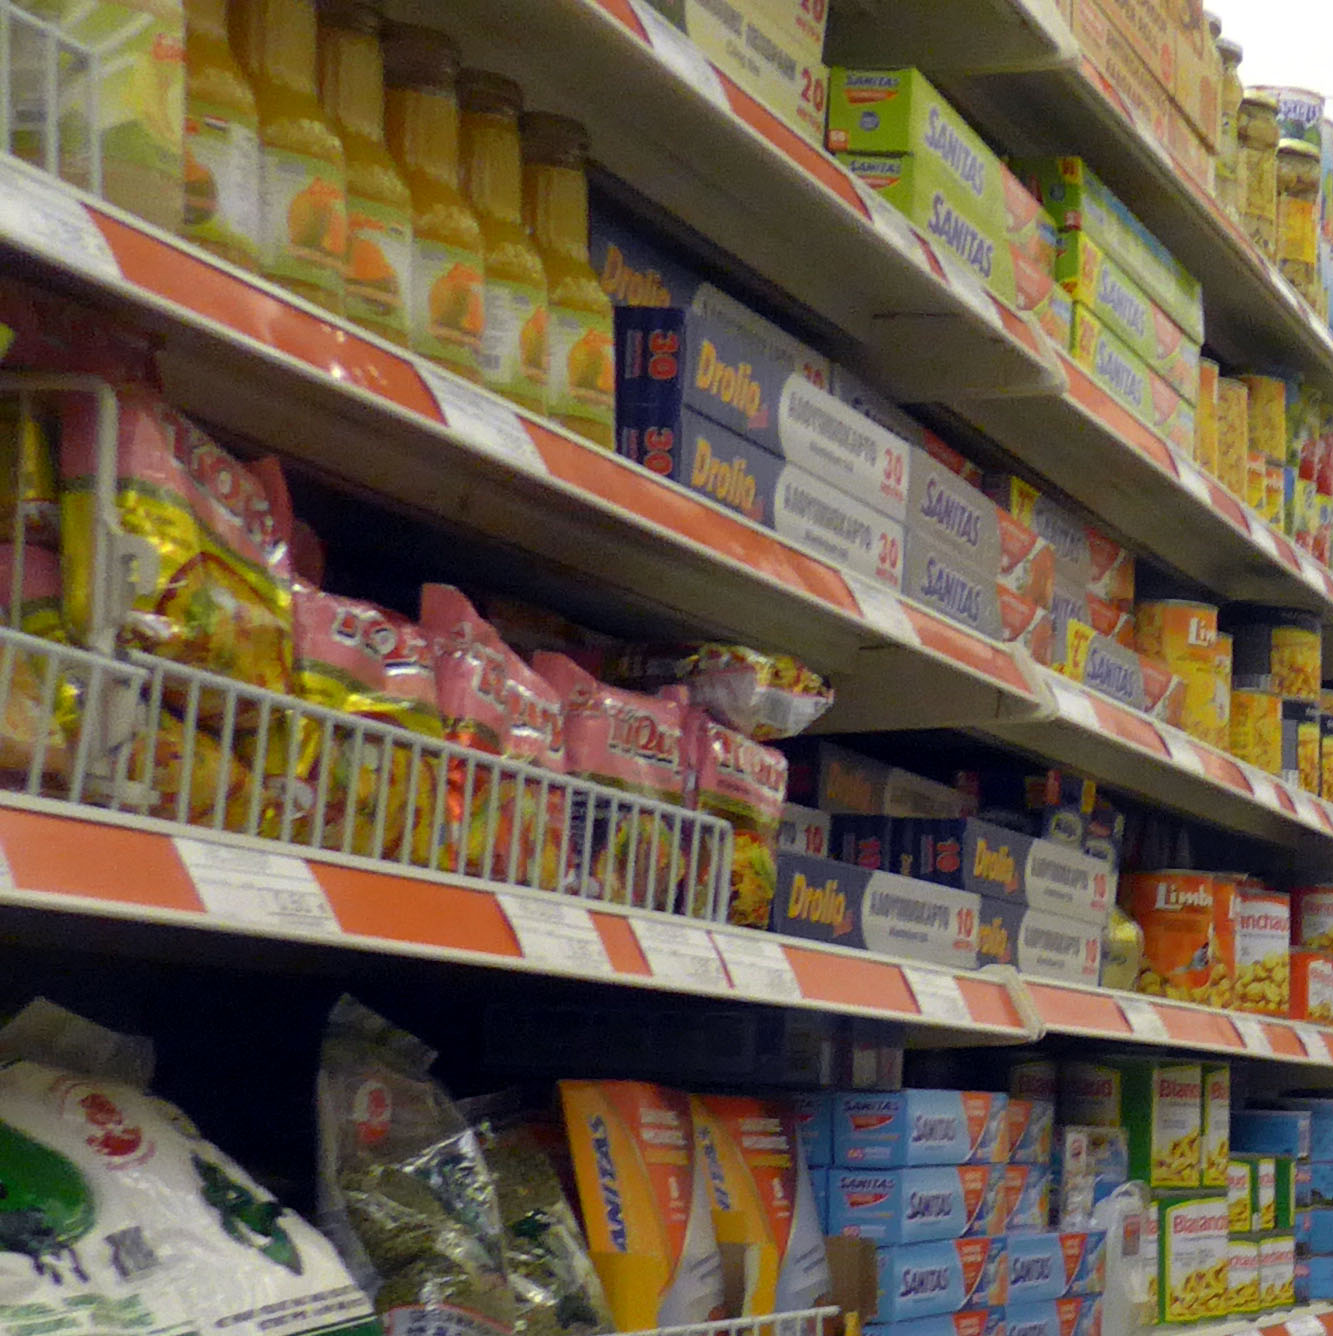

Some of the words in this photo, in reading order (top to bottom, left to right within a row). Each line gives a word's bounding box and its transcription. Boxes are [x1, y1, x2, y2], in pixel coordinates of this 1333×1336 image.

[845, 75, 901, 90] SANITAS
[849, 159, 901, 174] SANITAS
[925, 107, 984, 197] SANITAS
[928, 192, 993, 278] SANITAS
[648, 329, 679, 380] 30
[921, 477, 981, 546] SANITAS
[921, 556, 981, 622] SANITAS
[911, 1115, 957, 1142] SANITAS
[905, 1190, 954, 1219] SANITAS
[900, 1267, 949, 1297] SANITAS
